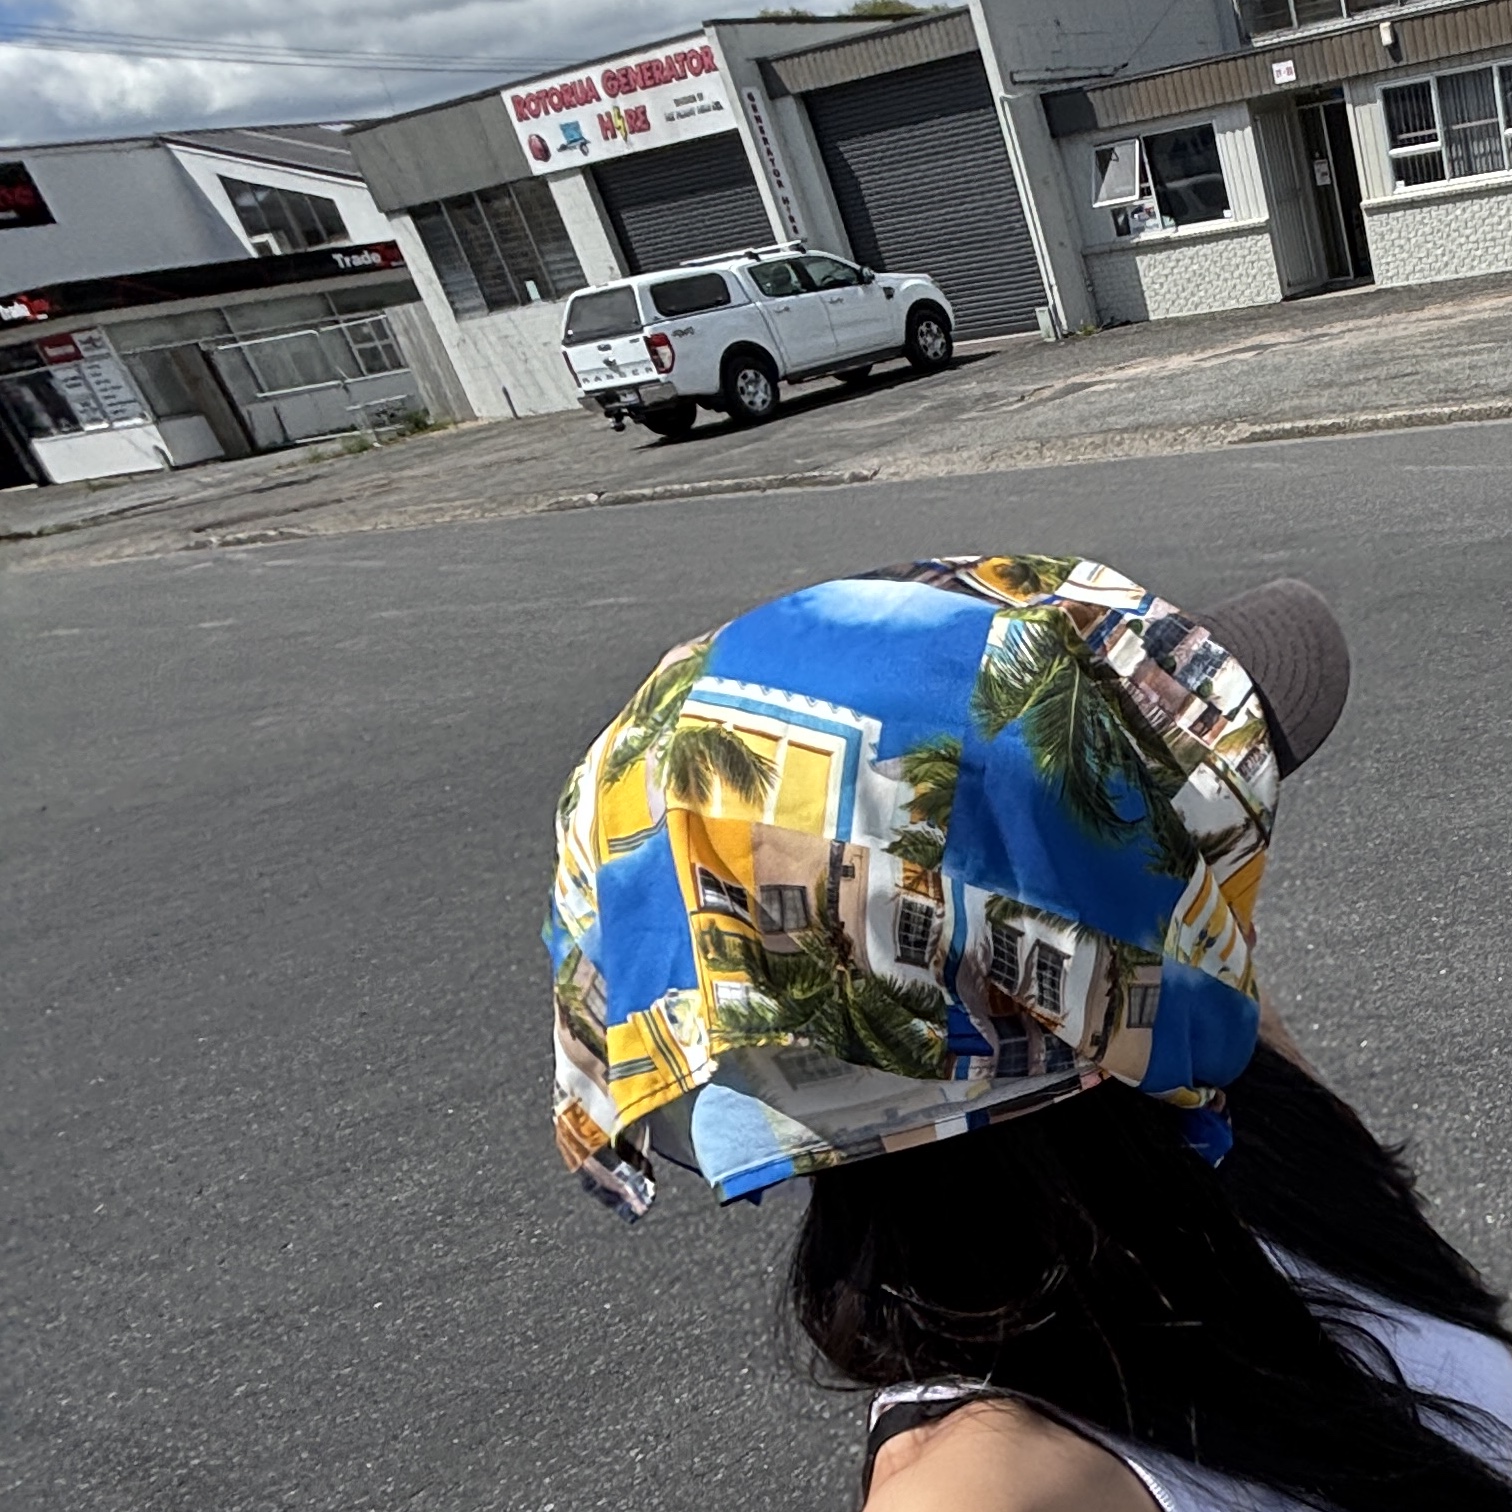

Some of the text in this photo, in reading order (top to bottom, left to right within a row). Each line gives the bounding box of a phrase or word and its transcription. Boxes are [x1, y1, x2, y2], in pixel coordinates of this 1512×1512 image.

[510, 45, 718, 122] ROTORUA GENERATOR
[747, 92, 784, 189] GENERATOR
